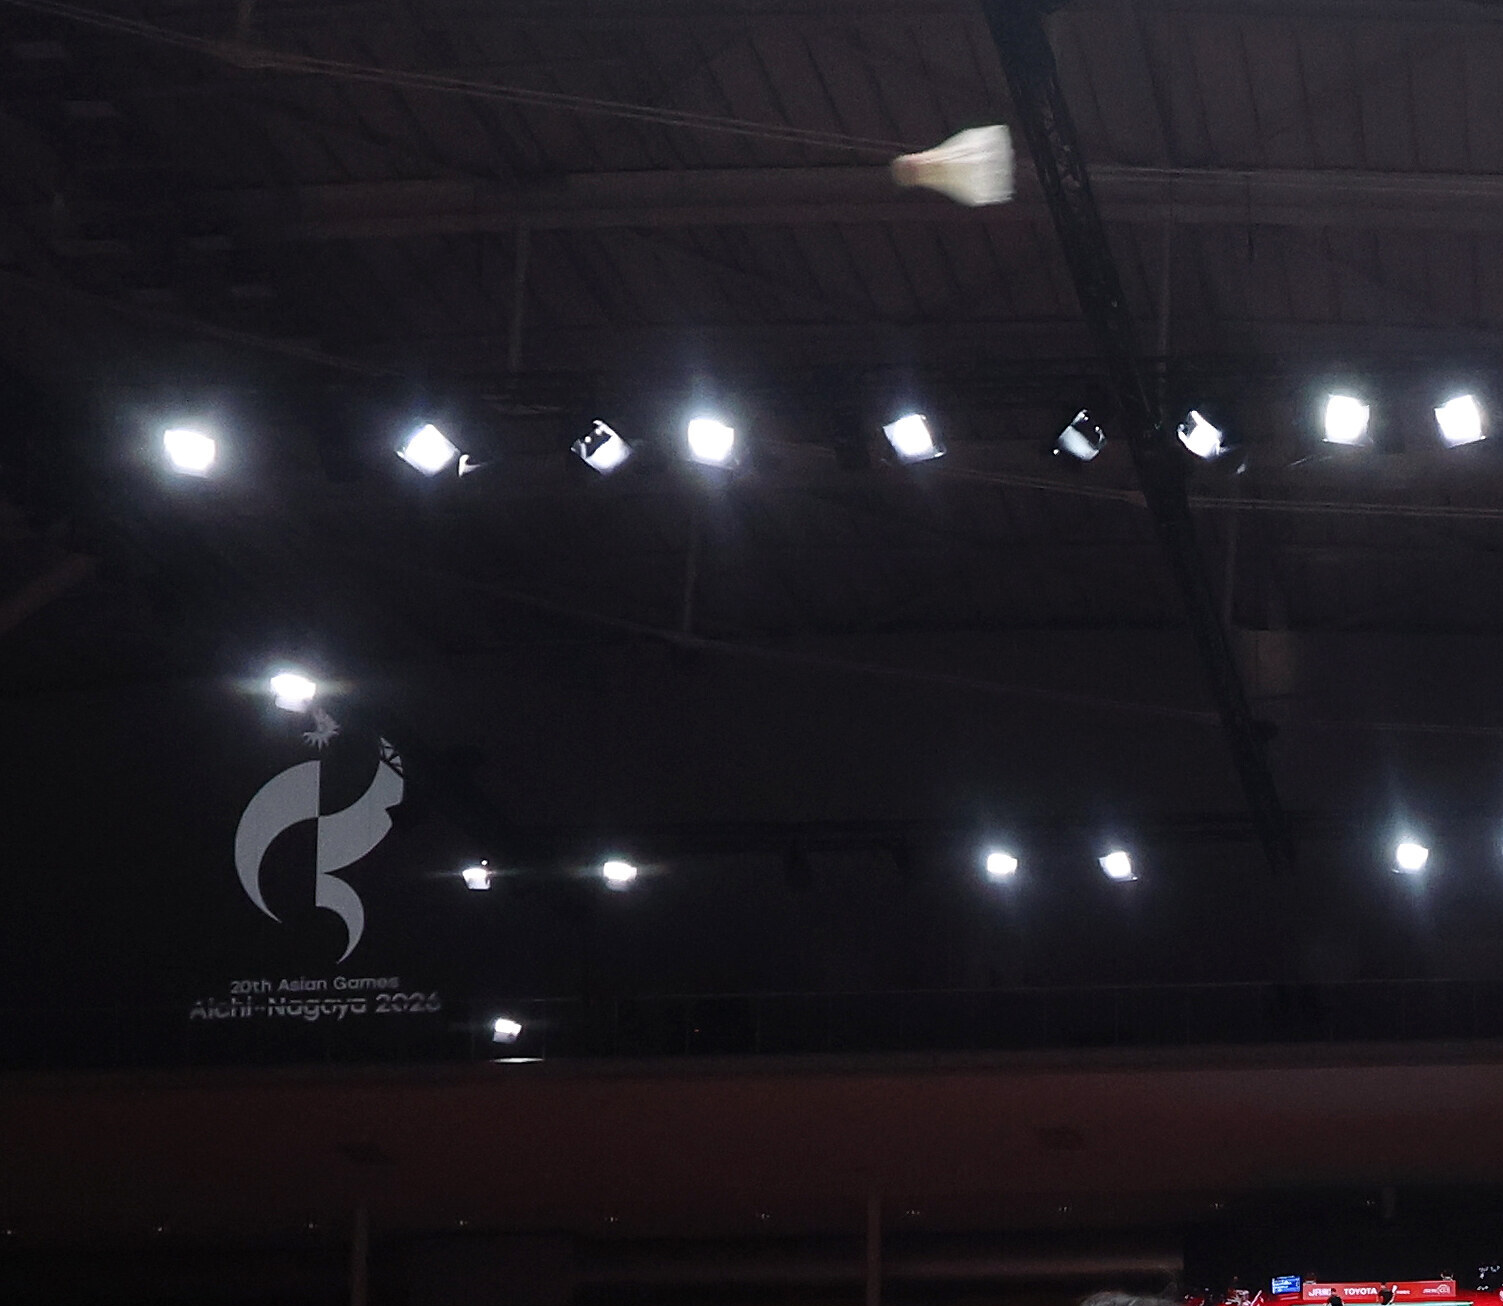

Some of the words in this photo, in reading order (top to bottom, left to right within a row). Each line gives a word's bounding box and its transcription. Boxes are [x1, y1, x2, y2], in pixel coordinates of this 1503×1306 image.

[230, 979, 272, 994] 20th
[277, 977, 328, 992] Asian
[332, 975, 399, 990] Games
[375, 991, 442, 1014] 2026
[1344, 1287, 1378, 1296] TOYOTA
